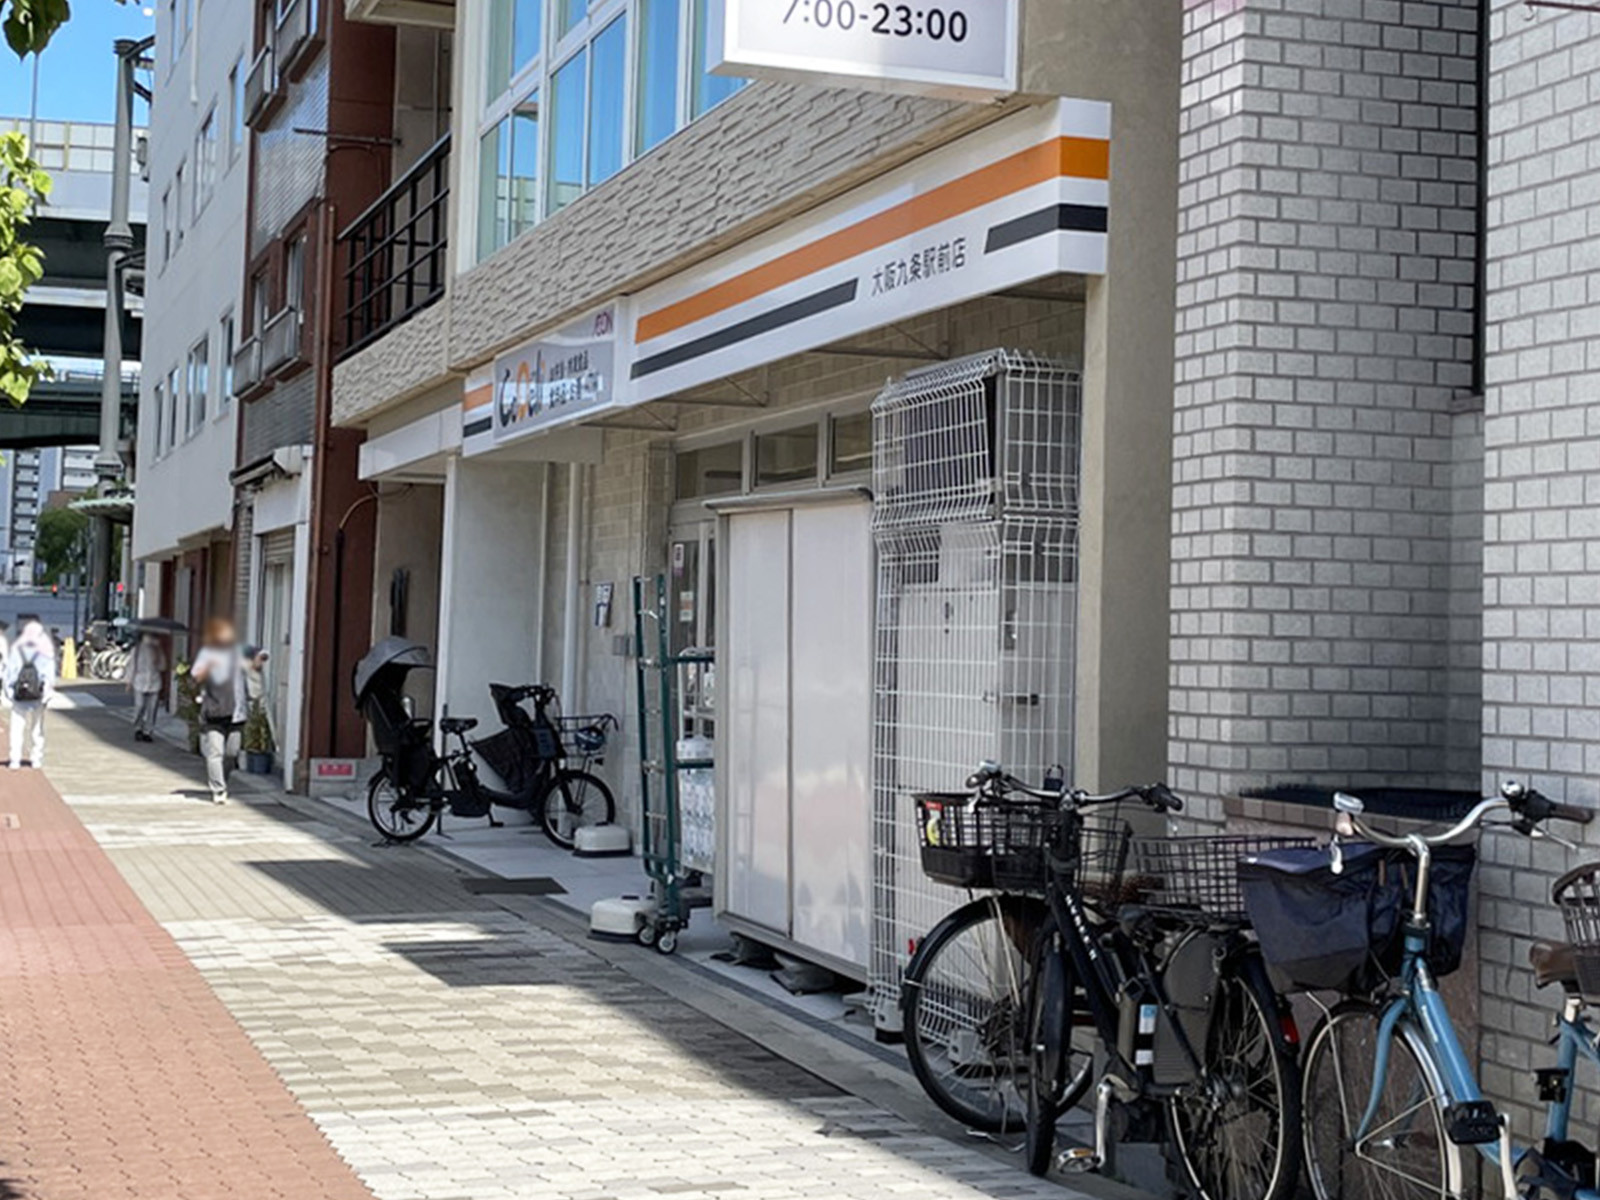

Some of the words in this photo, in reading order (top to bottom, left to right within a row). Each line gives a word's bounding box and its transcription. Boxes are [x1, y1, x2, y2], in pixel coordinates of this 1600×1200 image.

[871, 237, 966, 296] 大阪九条駅前店
